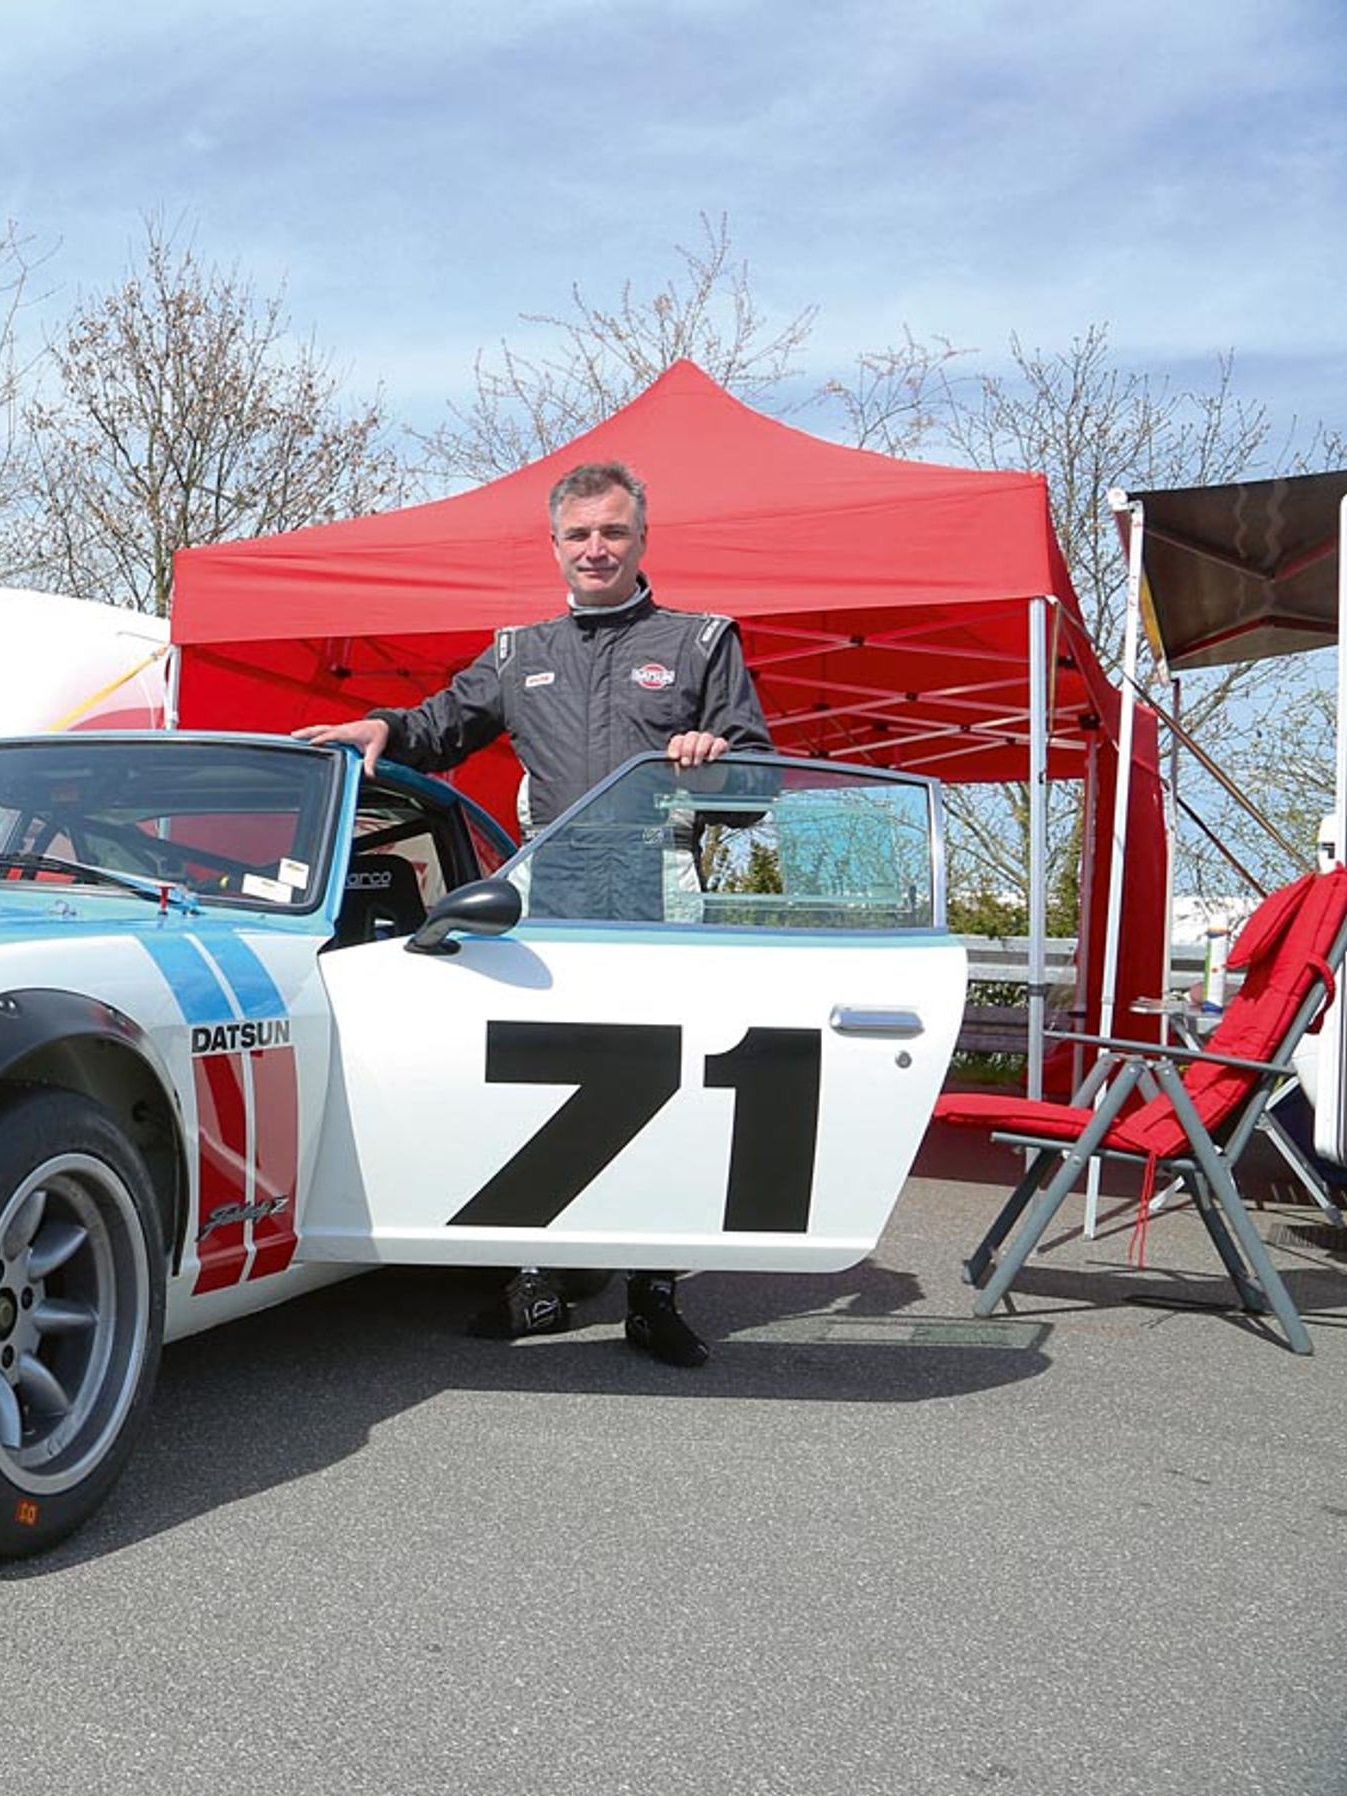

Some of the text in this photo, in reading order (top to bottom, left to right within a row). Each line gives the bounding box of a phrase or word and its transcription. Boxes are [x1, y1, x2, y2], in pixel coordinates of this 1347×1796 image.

[346, 871, 392, 886] arco
[192, 1020, 290, 1052] DATSUN
[445, 1019, 822, 1233] 71
